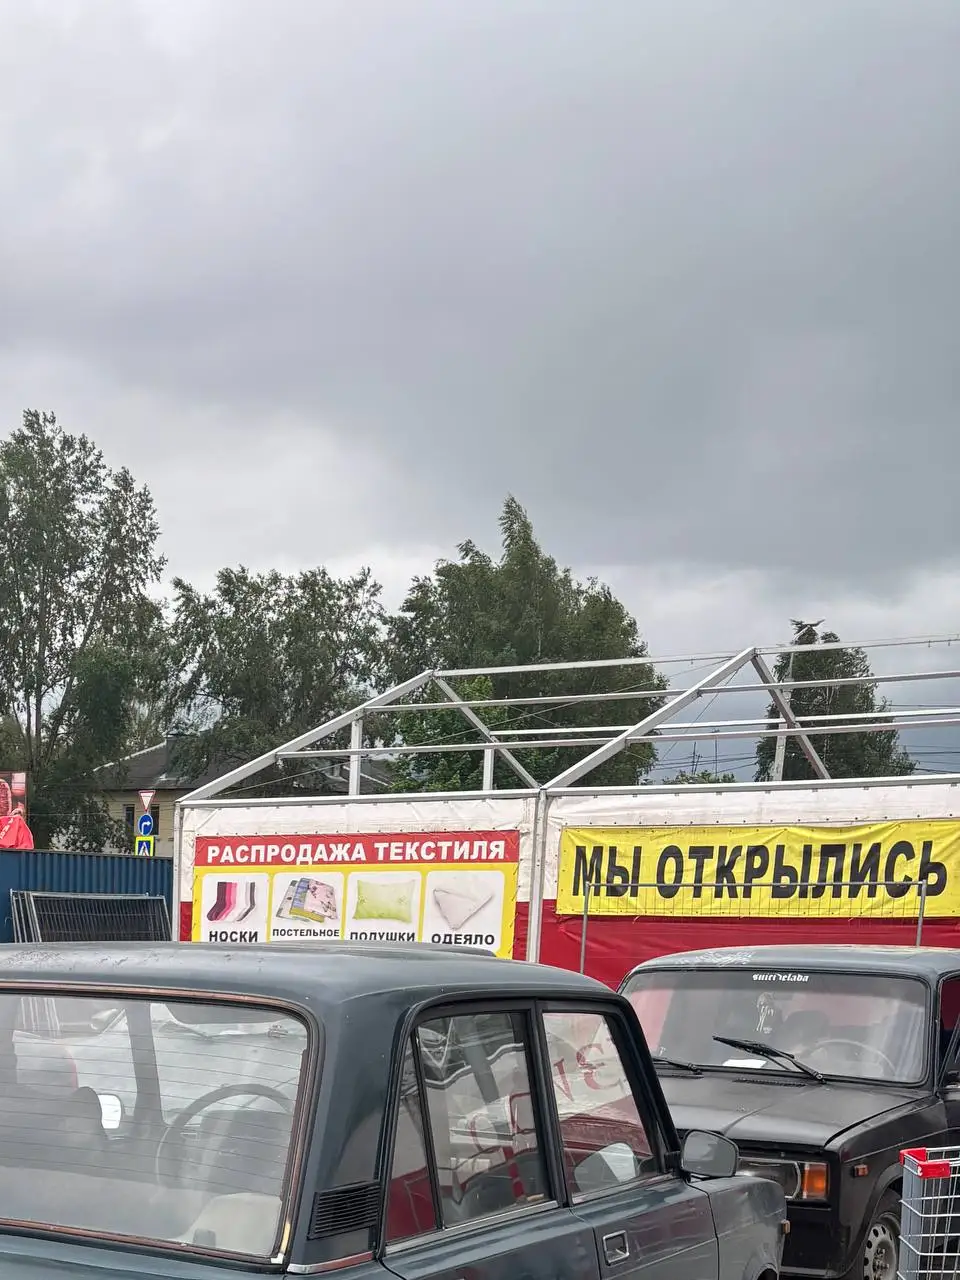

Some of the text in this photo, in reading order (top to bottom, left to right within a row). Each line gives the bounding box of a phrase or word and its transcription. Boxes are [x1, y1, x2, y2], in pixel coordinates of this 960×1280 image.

[207, 838, 506, 865] РАСПРОДАЖА ТЕКСТИЛЯ
[572, 840, 948, 899] МЫ ОТКРЫЛИСЬ
[208, 930, 259, 943] НОСКИ
[272, 928, 340, 938] ПОСТЕЛЬНОЕ
[431, 933, 495, 946] ОДЕЯЛО
